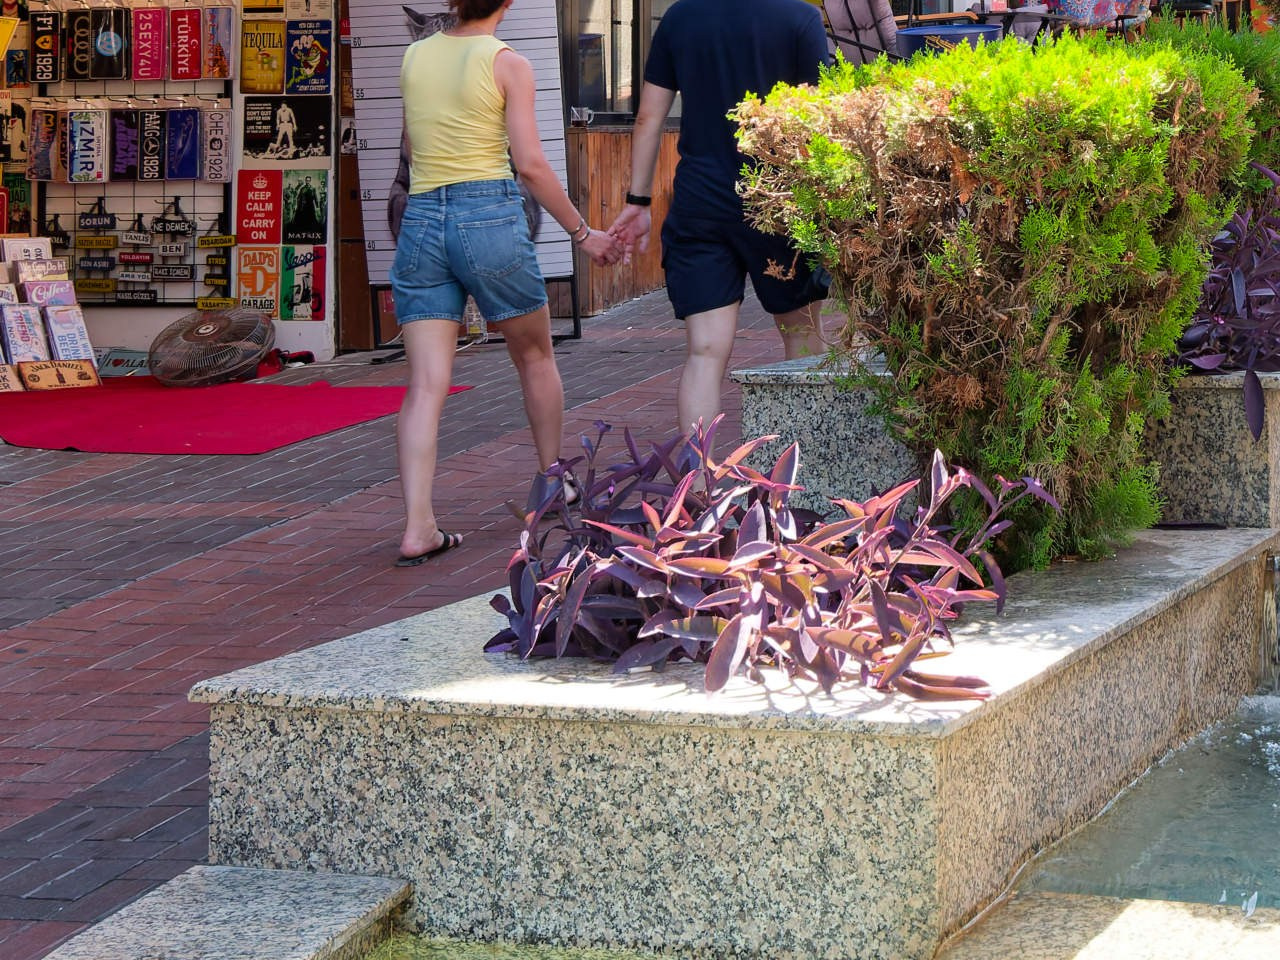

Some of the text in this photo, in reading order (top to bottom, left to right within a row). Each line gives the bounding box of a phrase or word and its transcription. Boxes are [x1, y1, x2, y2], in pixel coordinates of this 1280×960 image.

[138, 13, 152, 76] 2SEXY4U
[176, 14, 190, 75] TÜRKİYE
[243, 31, 283, 49] TEQUILA
[352, 37, 362, 47] 60
[36, 16, 53, 80] F1 1929
[356, 89, 365, 99] 55
[143, 112, 160, 179] AMG 1926
[208, 112, 223, 180] CHE 1928
[359, 140, 368, 149] 50
[247, 191, 272, 201] KEEP
[362, 190, 372, 200] 45
[245, 202, 273, 212] CALM
[80, 217, 111, 226] SORUN
[242, 219, 275, 228] CARRY
[153, 222, 190, 232] NE DEMEK
[251, 230, 267, 240] ON
[161, 245, 182, 253] BEN
[367, 240, 376, 250] 40
[243, 252, 275, 267] DAD'S
[241, 298, 275, 310] GARAGE
[31, 361, 51, 372] JACK
